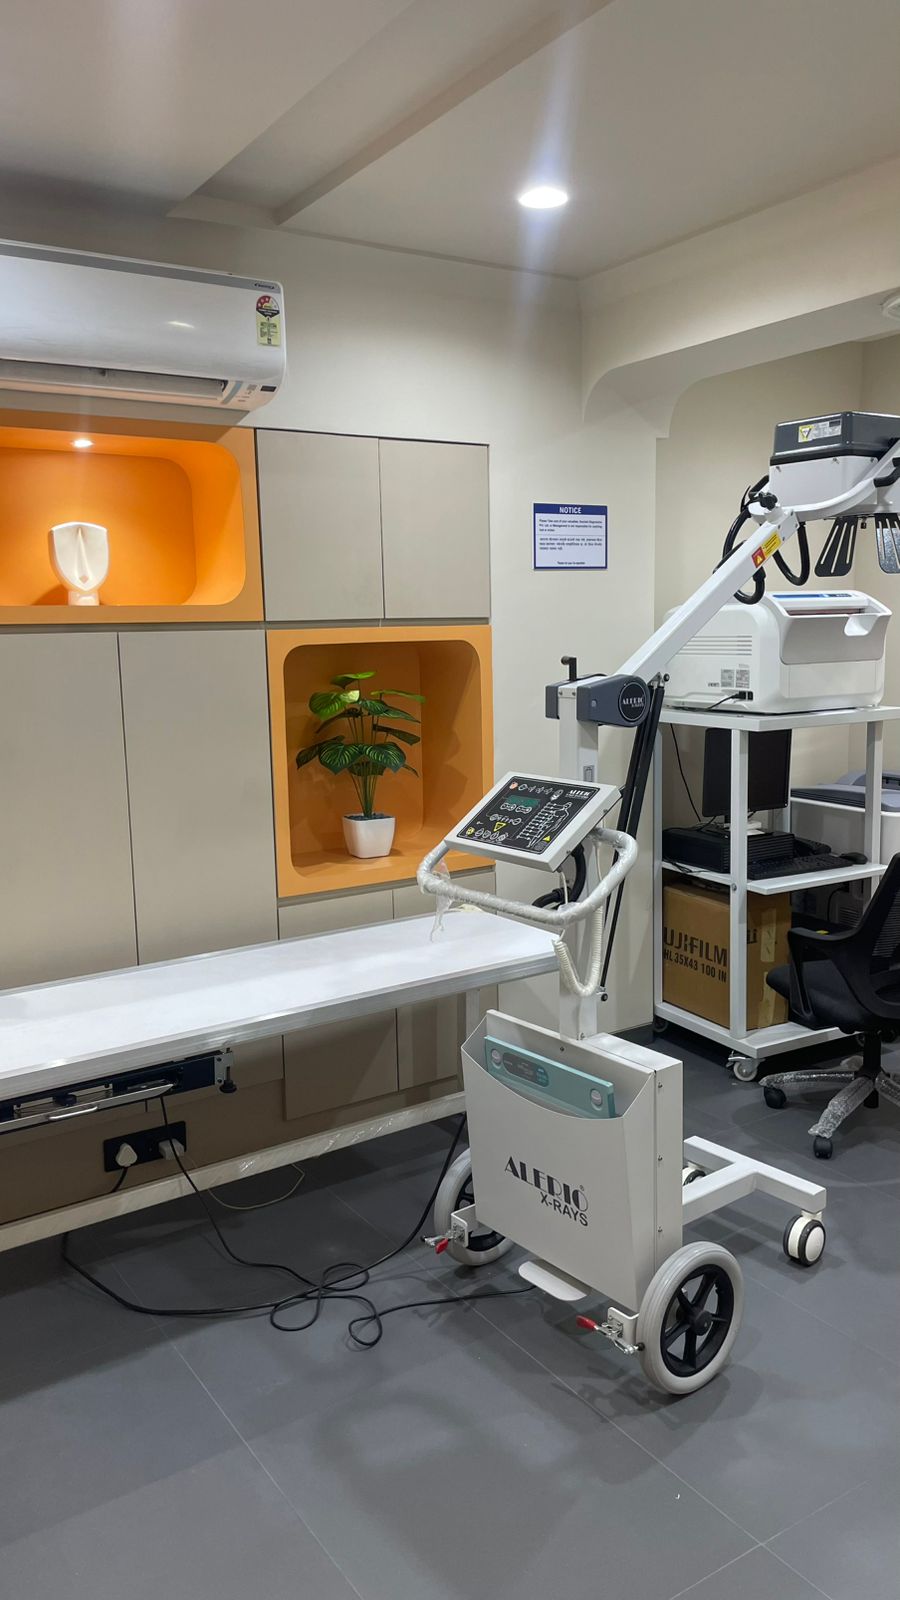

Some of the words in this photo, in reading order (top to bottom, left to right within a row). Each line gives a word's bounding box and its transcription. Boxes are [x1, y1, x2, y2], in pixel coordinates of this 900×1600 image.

[559, 506, 582, 514] NOTICE
[663, 926, 728, 967] UJIFILM
[701, 963, 716, 978] 100
[504, 1156, 589, 1212] ALERIO
[540, 1191, 588, 1227] X-RAYS
